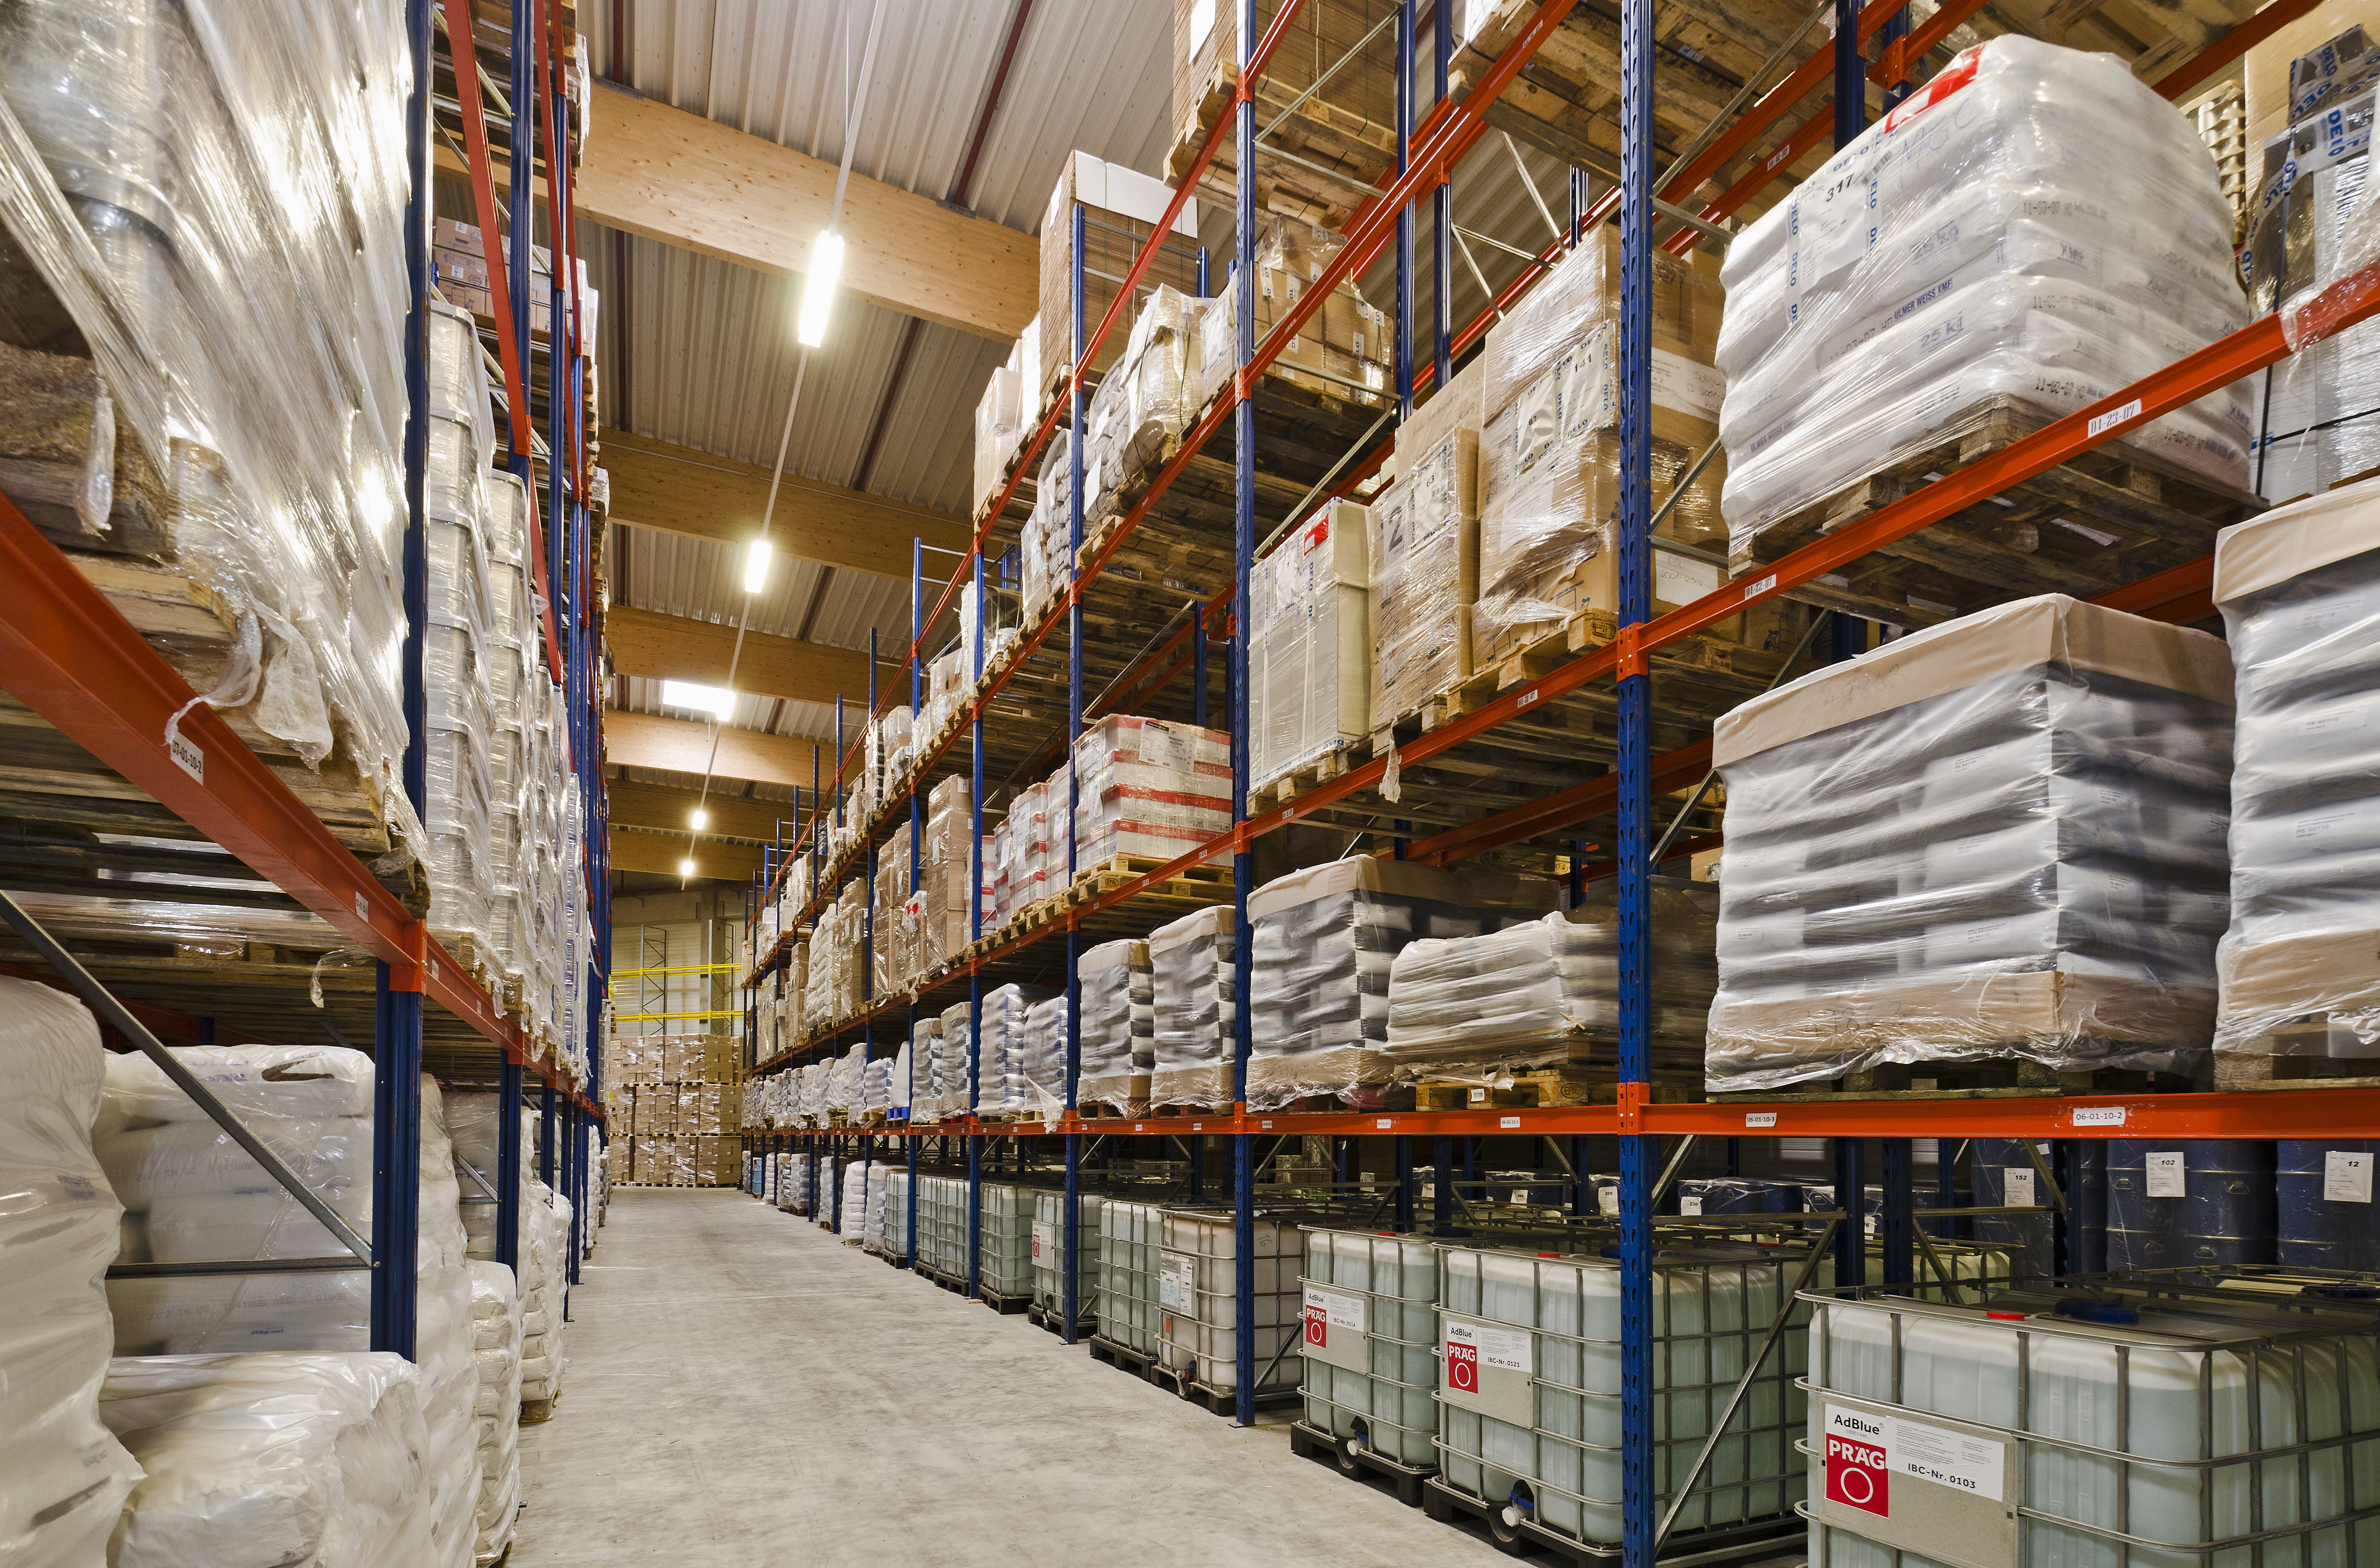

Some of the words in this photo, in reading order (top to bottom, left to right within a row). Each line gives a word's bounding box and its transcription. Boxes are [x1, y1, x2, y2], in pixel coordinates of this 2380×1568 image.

[2327, 109, 2346, 157] DELO
[1826, 172, 1855, 202] 317
[1790, 251, 1799, 287] DELO
[1895, 301, 1915, 320] ULMER
[1917, 289, 1936, 306] WEISS
[1937, 279, 1952, 294] XMF
[1574, 354, 1592, 373] 141
[1567, 418, 1588, 438] DELO
[1426, 475, 1435, 487] 63
[1824, 664, 1906, 708] 49863
[2075, 1111, 2123, 1121] 06-01-10-2
[1307, 1307, 1325, 1323] PRÄG
[1450, 1327, 1472, 1338] AdBlue
[1448, 1345, 1476, 1362] PRÄG
[1487, 1357, 1506, 1365] IBC-Nr.
[1834, 1414, 1880, 1436] AdBlue
[1829, 1439, 1885, 1470] PRÄG
[1907, 1462, 1947, 1481] IBC-Nr.
[1950, 1475, 1976, 1489] 0103
